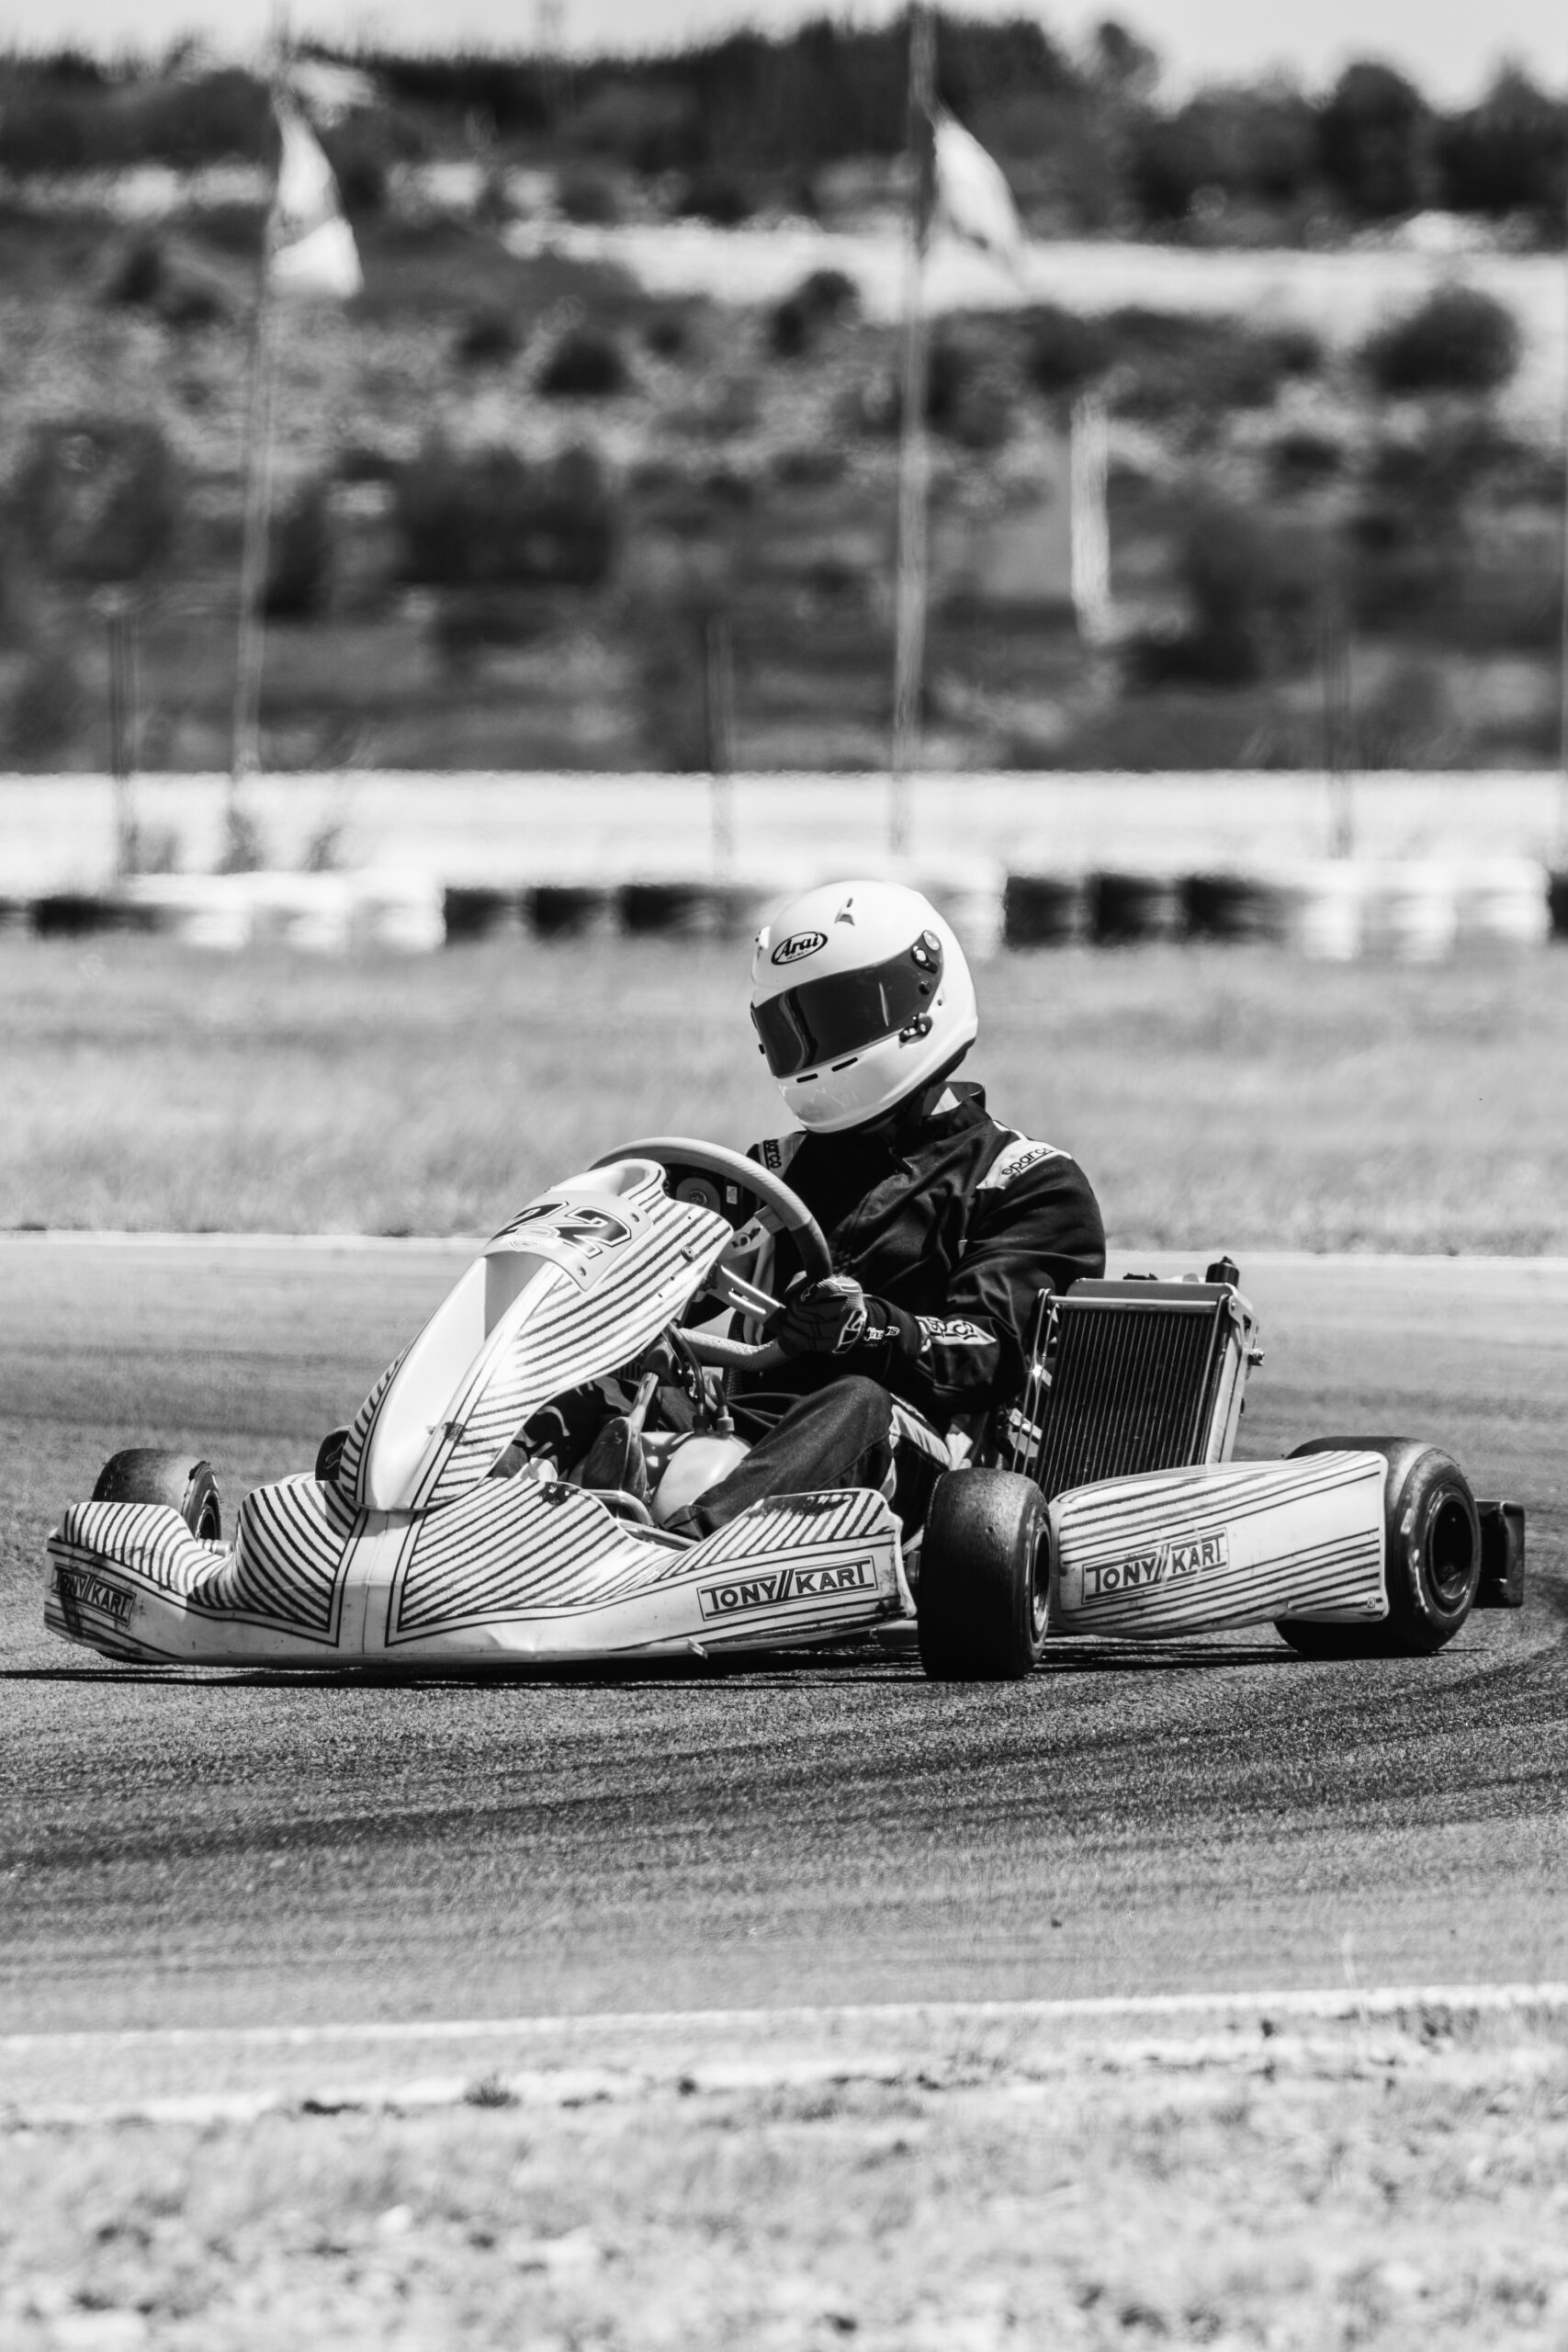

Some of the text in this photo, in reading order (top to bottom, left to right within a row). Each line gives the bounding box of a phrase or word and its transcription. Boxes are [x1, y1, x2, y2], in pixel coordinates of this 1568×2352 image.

[774, 933, 818, 962] Arai
[765, 1139, 782, 1168] arco
[1001, 1148, 1054, 1177] sparc
[926, 1317, 976, 1339] spco
[1086, 1532, 1224, 1592] TONY KART
[92, 1579, 134, 1616] KART
[701, 1559, 871, 1610] TONY KART
